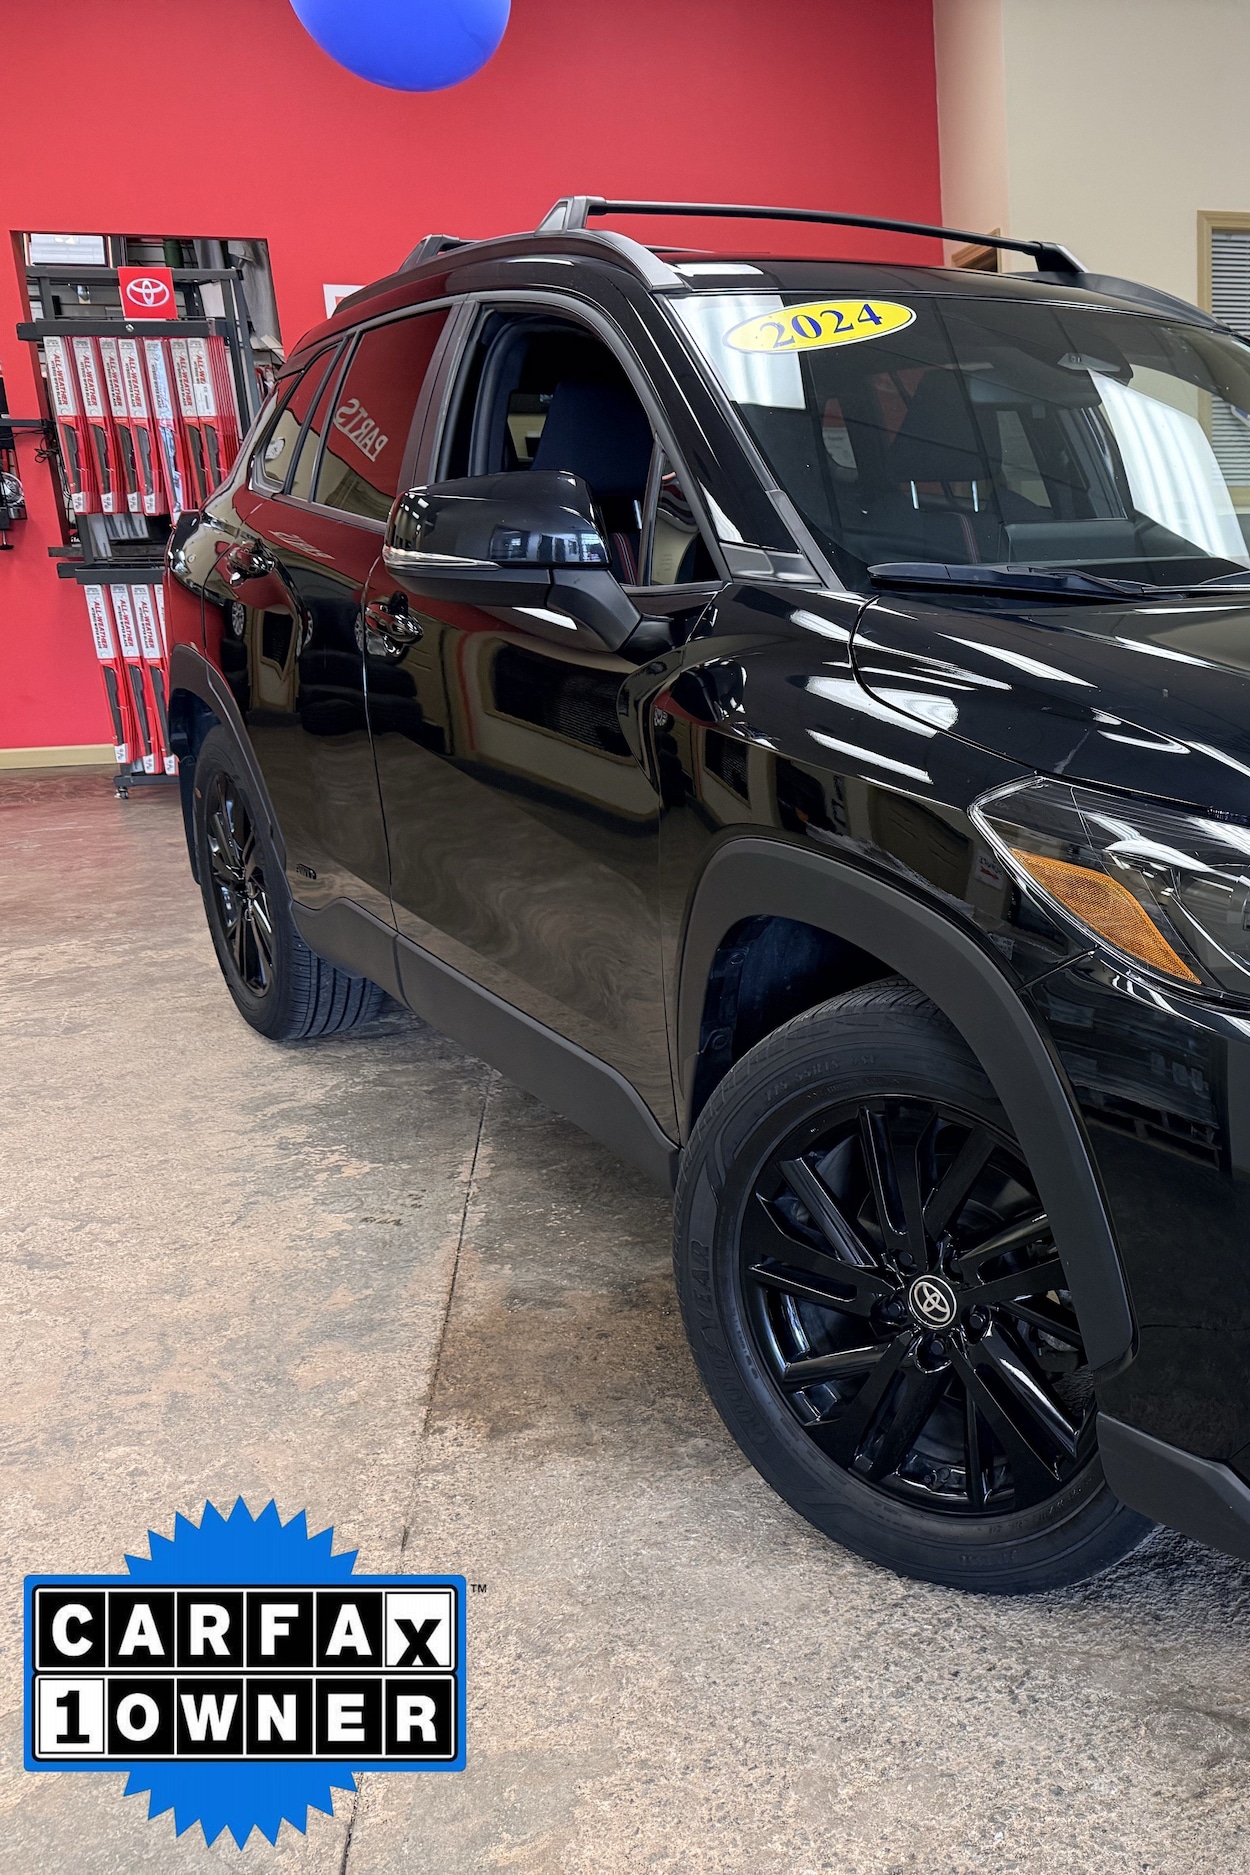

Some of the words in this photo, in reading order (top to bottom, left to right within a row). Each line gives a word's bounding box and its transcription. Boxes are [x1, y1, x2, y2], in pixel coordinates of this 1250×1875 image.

[760, 303, 882, 348] 2024
[54, 354, 68, 405] ALL-WEATHER
[84, 356, 97, 406] ALL-WEATHER
[110, 356, 121, 406] ALL-WEATHER
[129, 357, 141, 407] ALL-WEATHER
[180, 356, 191, 406] ALL-WEATHER
[94, 601, 107, 648] ALL-WEATHER
[120, 600, 133, 646] ALL-WEATHER
[141, 601, 154, 648] ALL-WEATHER
